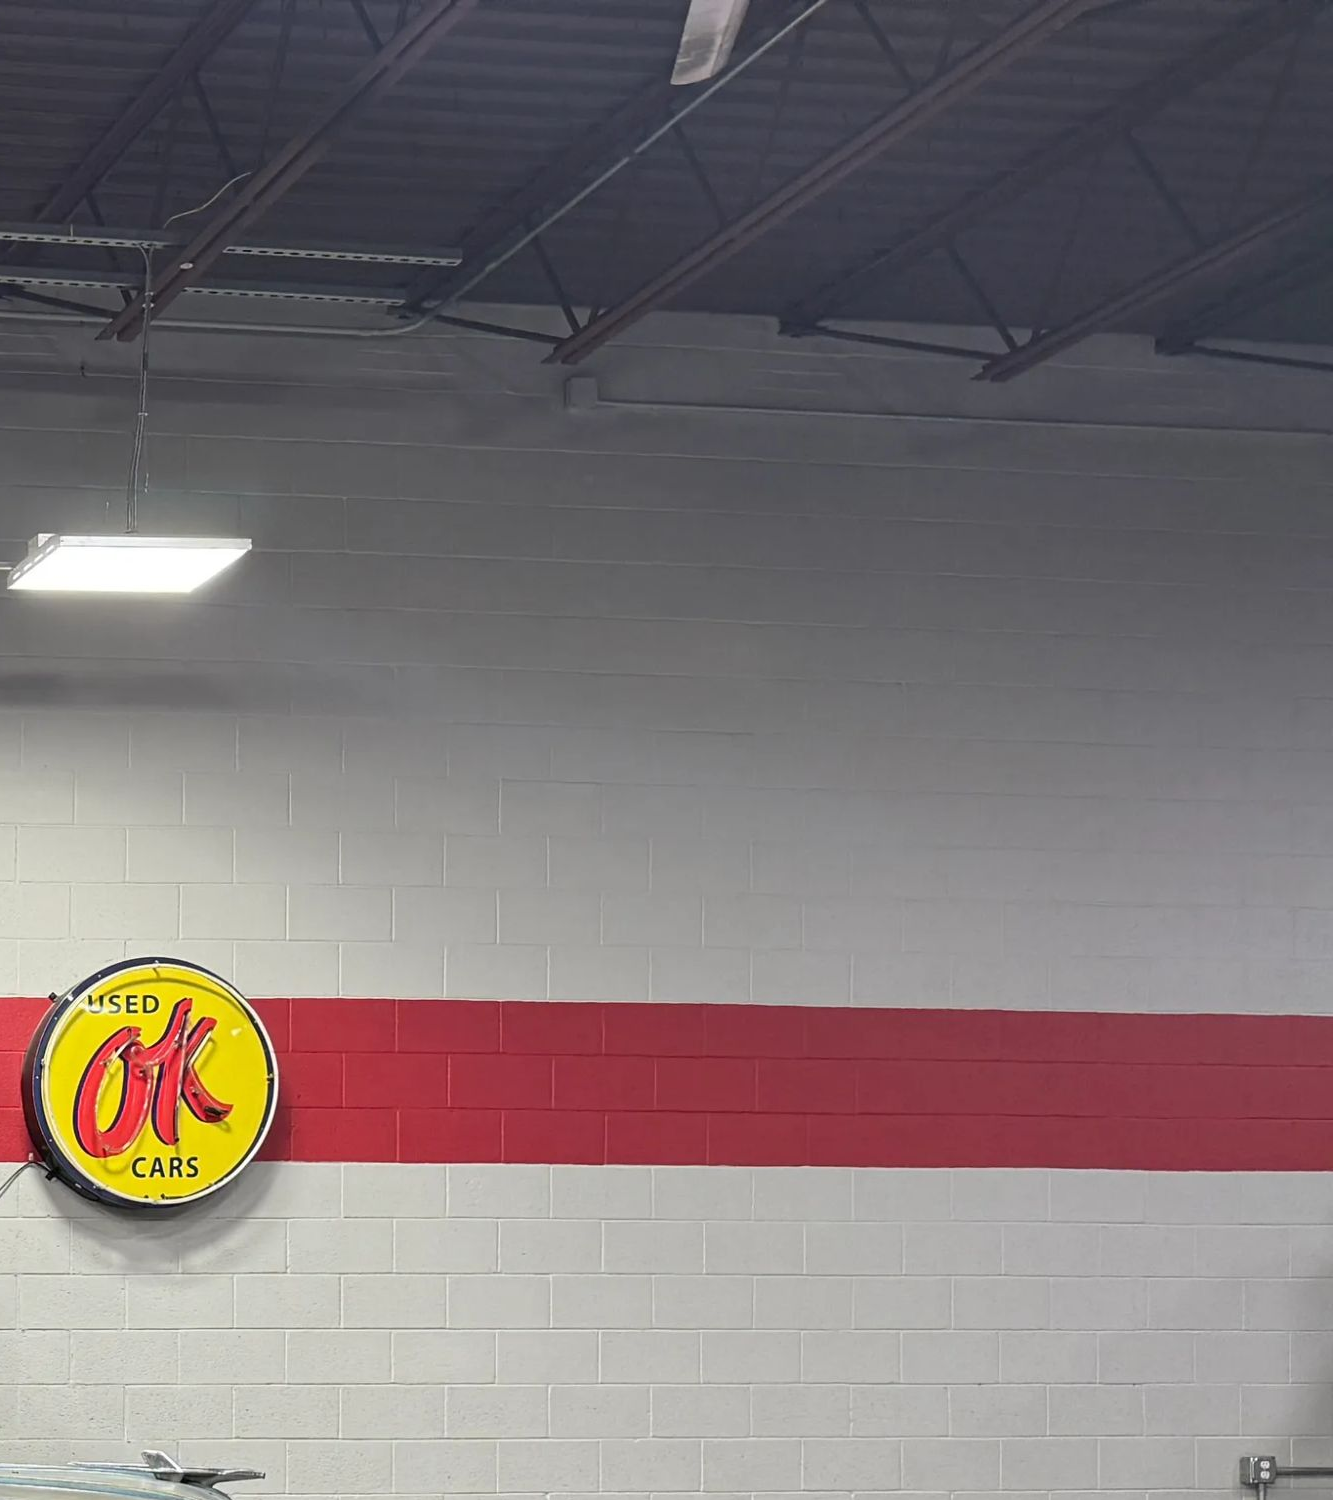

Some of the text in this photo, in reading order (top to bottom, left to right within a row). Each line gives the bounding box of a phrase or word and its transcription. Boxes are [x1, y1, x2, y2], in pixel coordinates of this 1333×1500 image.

[88, 994, 159, 1014] USED
[73, 997, 233, 1158] OK
[132, 1156, 199, 1178] CARS
